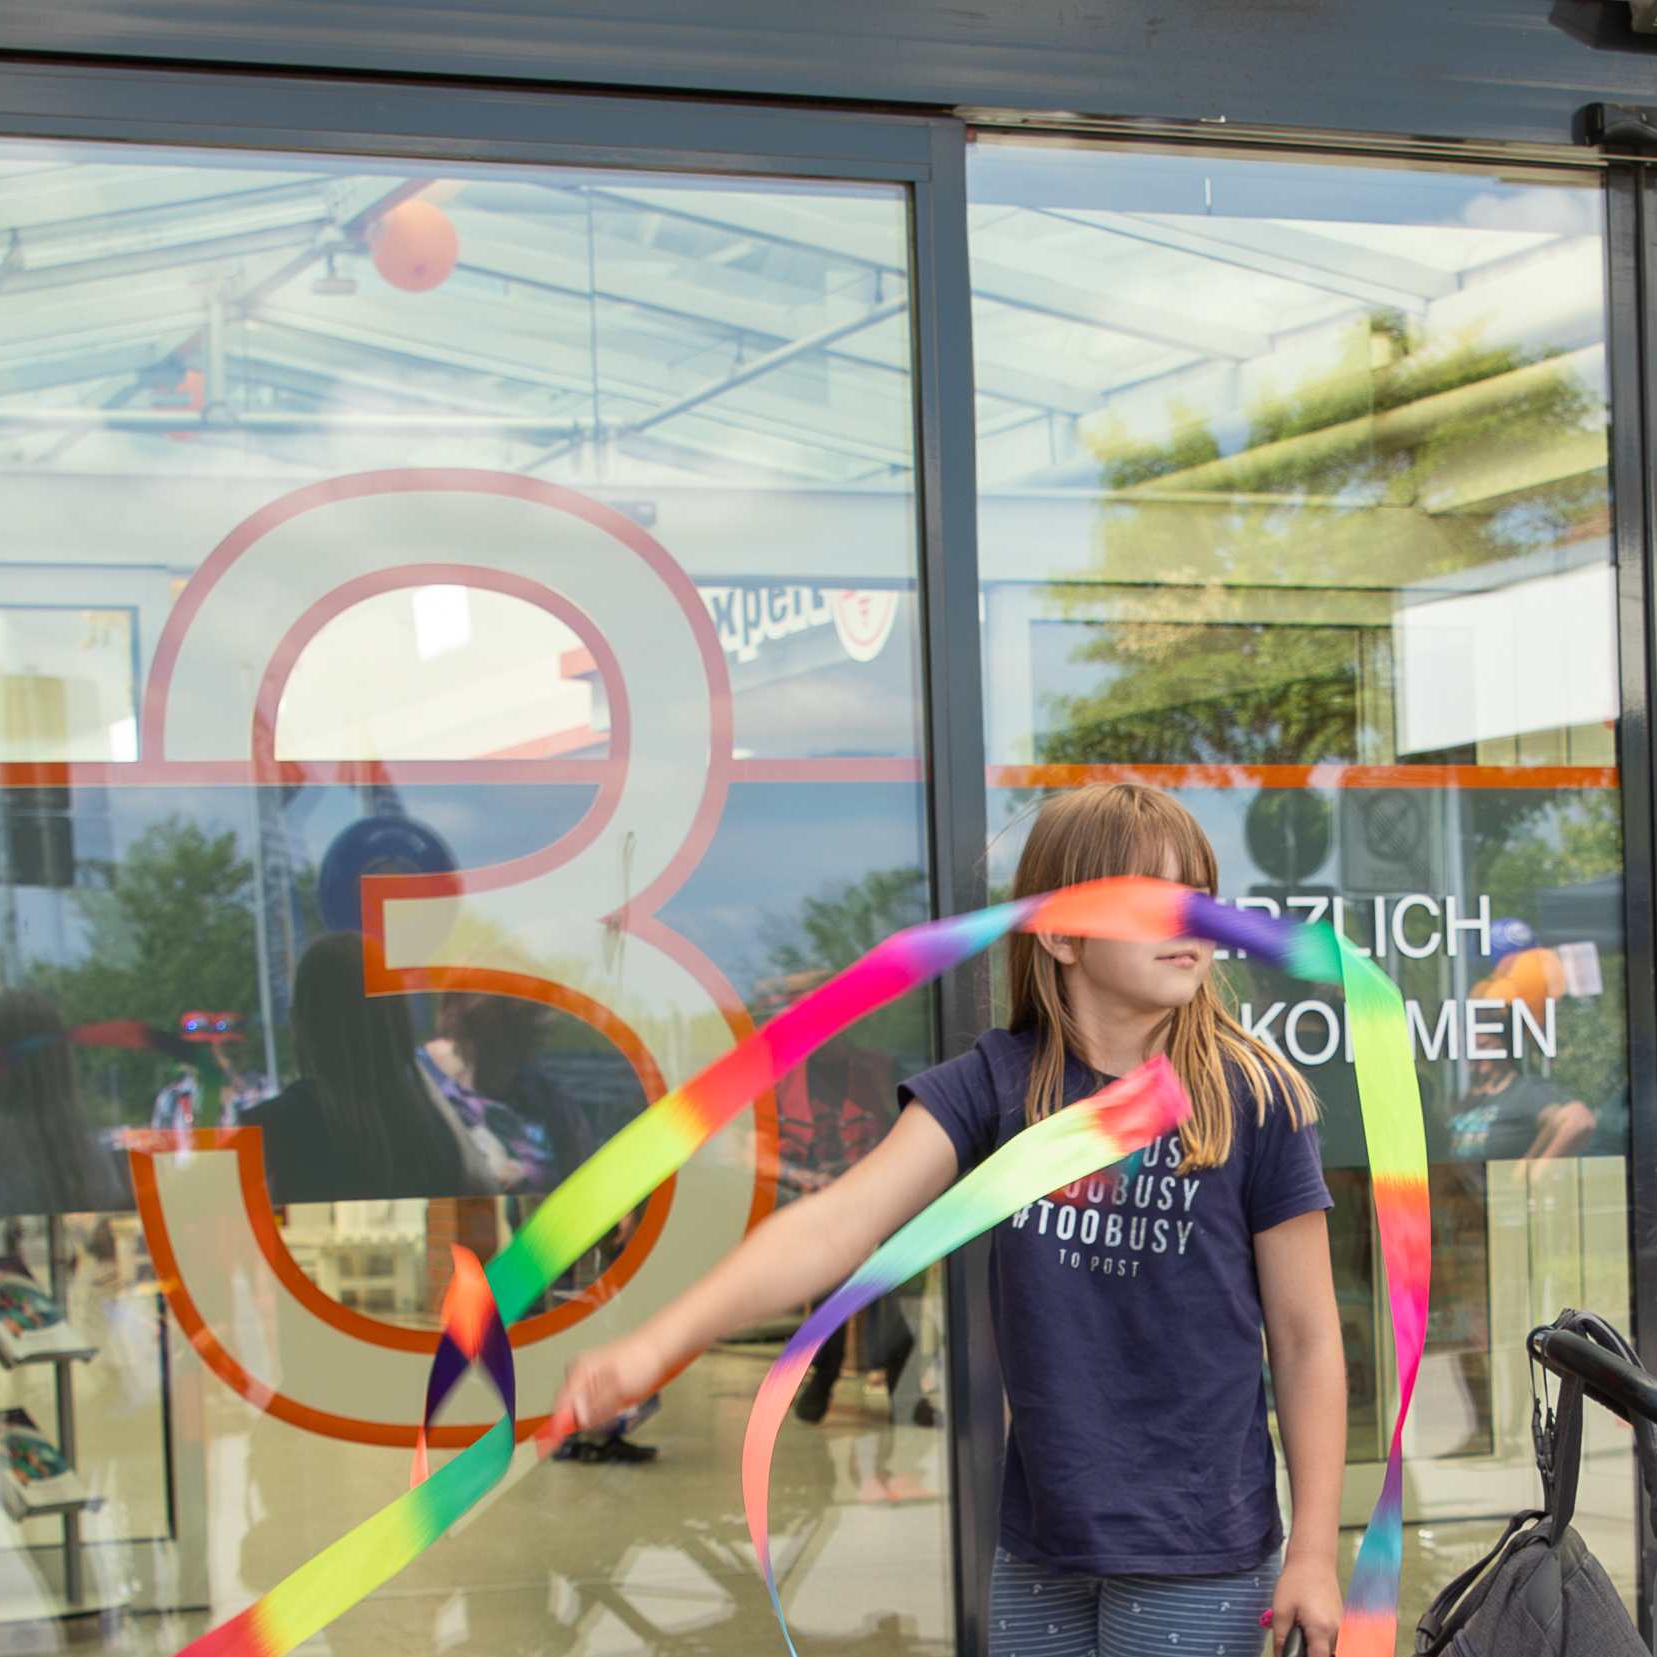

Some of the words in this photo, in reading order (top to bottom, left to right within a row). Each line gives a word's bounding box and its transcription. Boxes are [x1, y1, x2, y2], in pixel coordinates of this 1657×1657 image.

[1240, 997, 1557, 1066] KOMEN
[1011, 1199, 1194, 1255] #TOOBUSY
[1059, 1248, 1081, 1268] TO
[1090, 1255, 1140, 1277] POST
